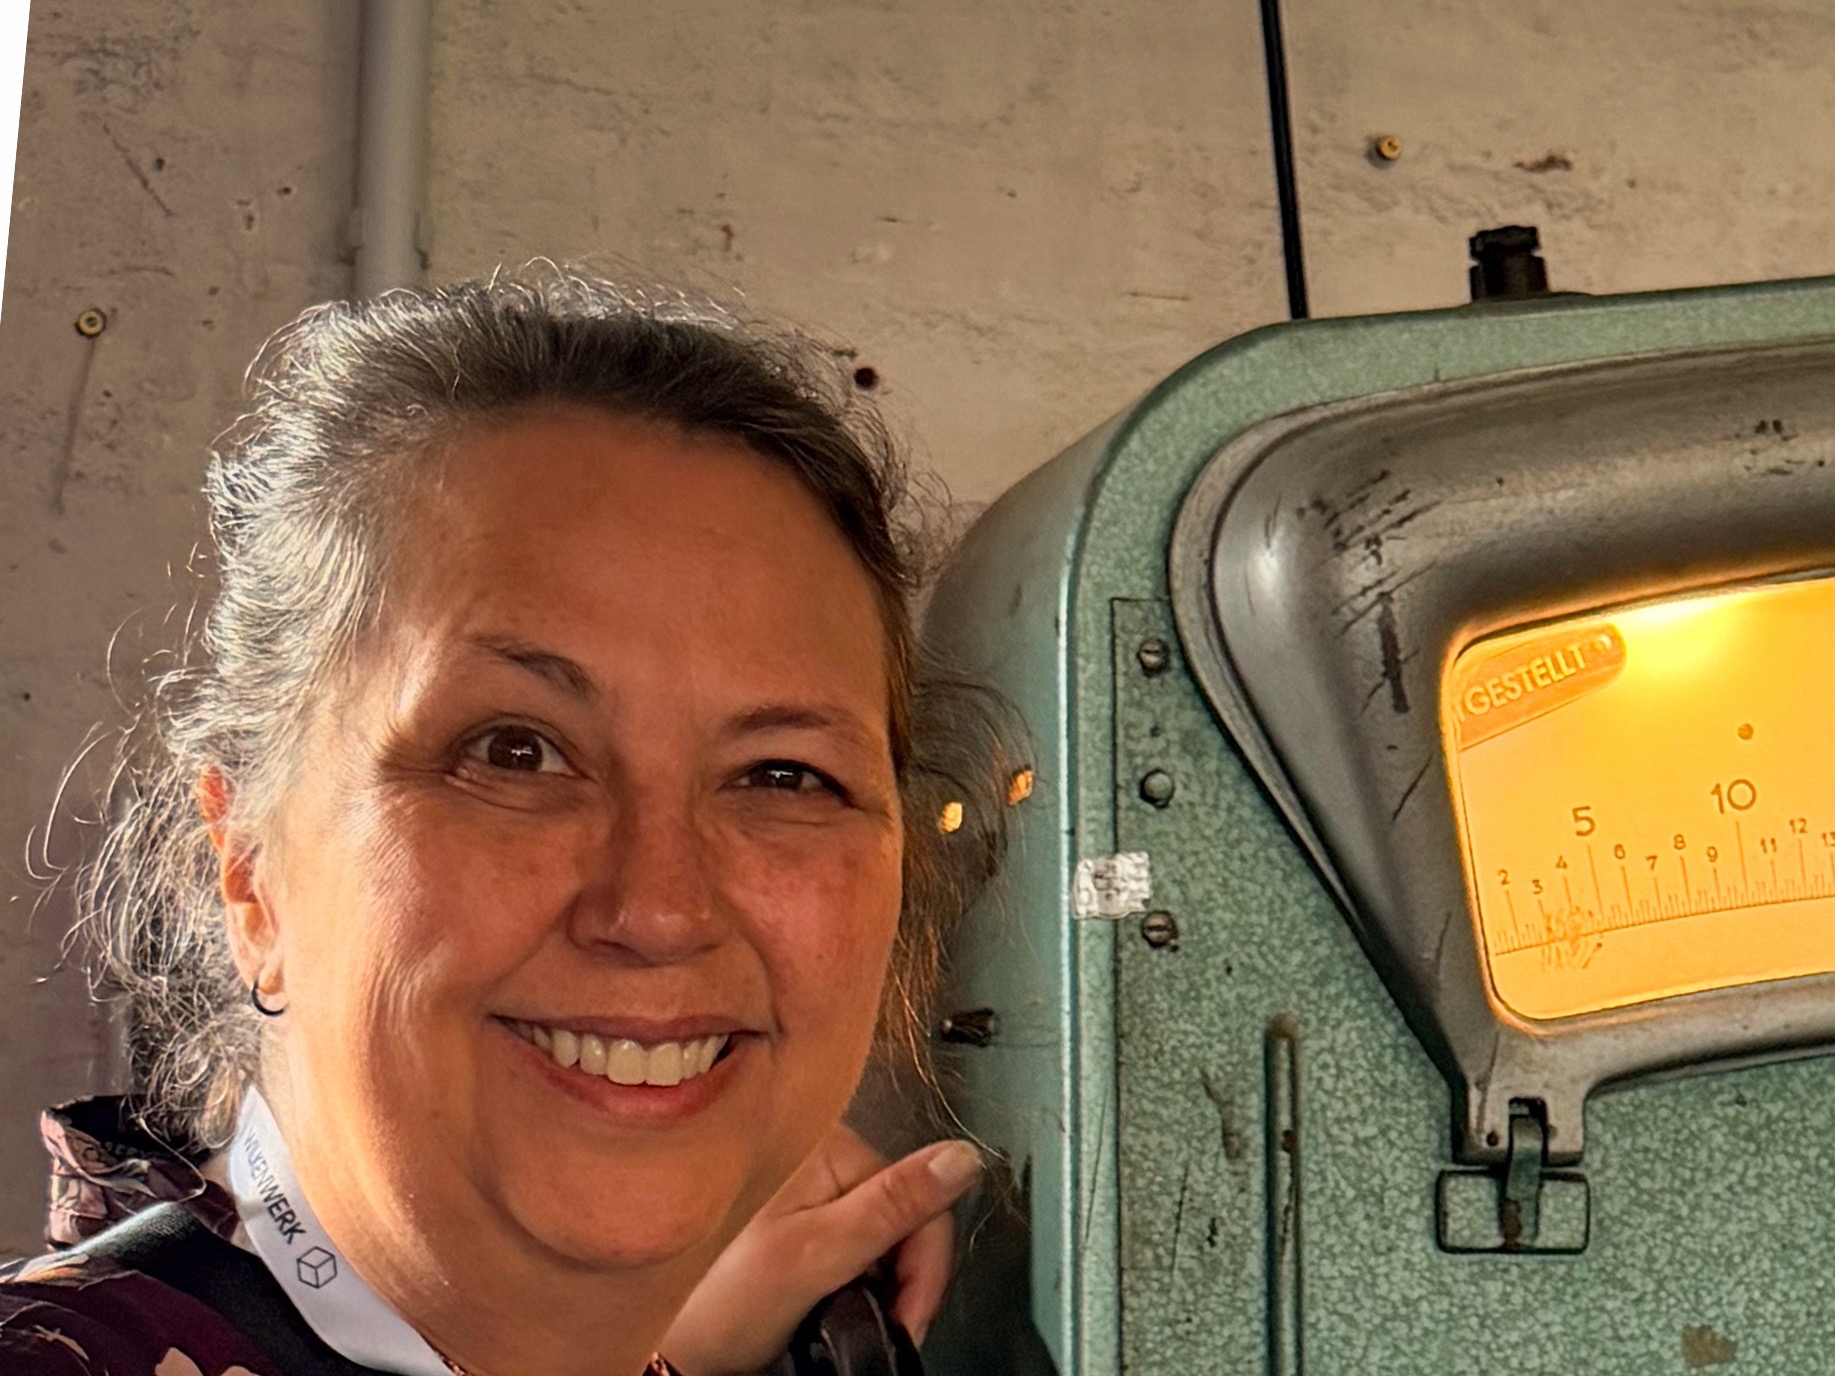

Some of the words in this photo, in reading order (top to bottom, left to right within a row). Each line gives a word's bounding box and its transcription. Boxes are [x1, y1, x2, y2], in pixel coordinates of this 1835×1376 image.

[1572, 806, 1596, 837] 5
[1710, 778, 1757, 814] 10
[1498, 869, 1510, 886] 2
[1532, 879, 1543, 894] 3
[1556, 855, 1568, 870] 4
[1614, 843, 1626, 860] 6
[1646, 855, 1658, 872] 7
[1673, 834, 1686, 850] 8
[1706, 846, 1718, 863] 9
[1760, 837, 1777, 853] 11
[1789, 818, 1808, 834] 12
